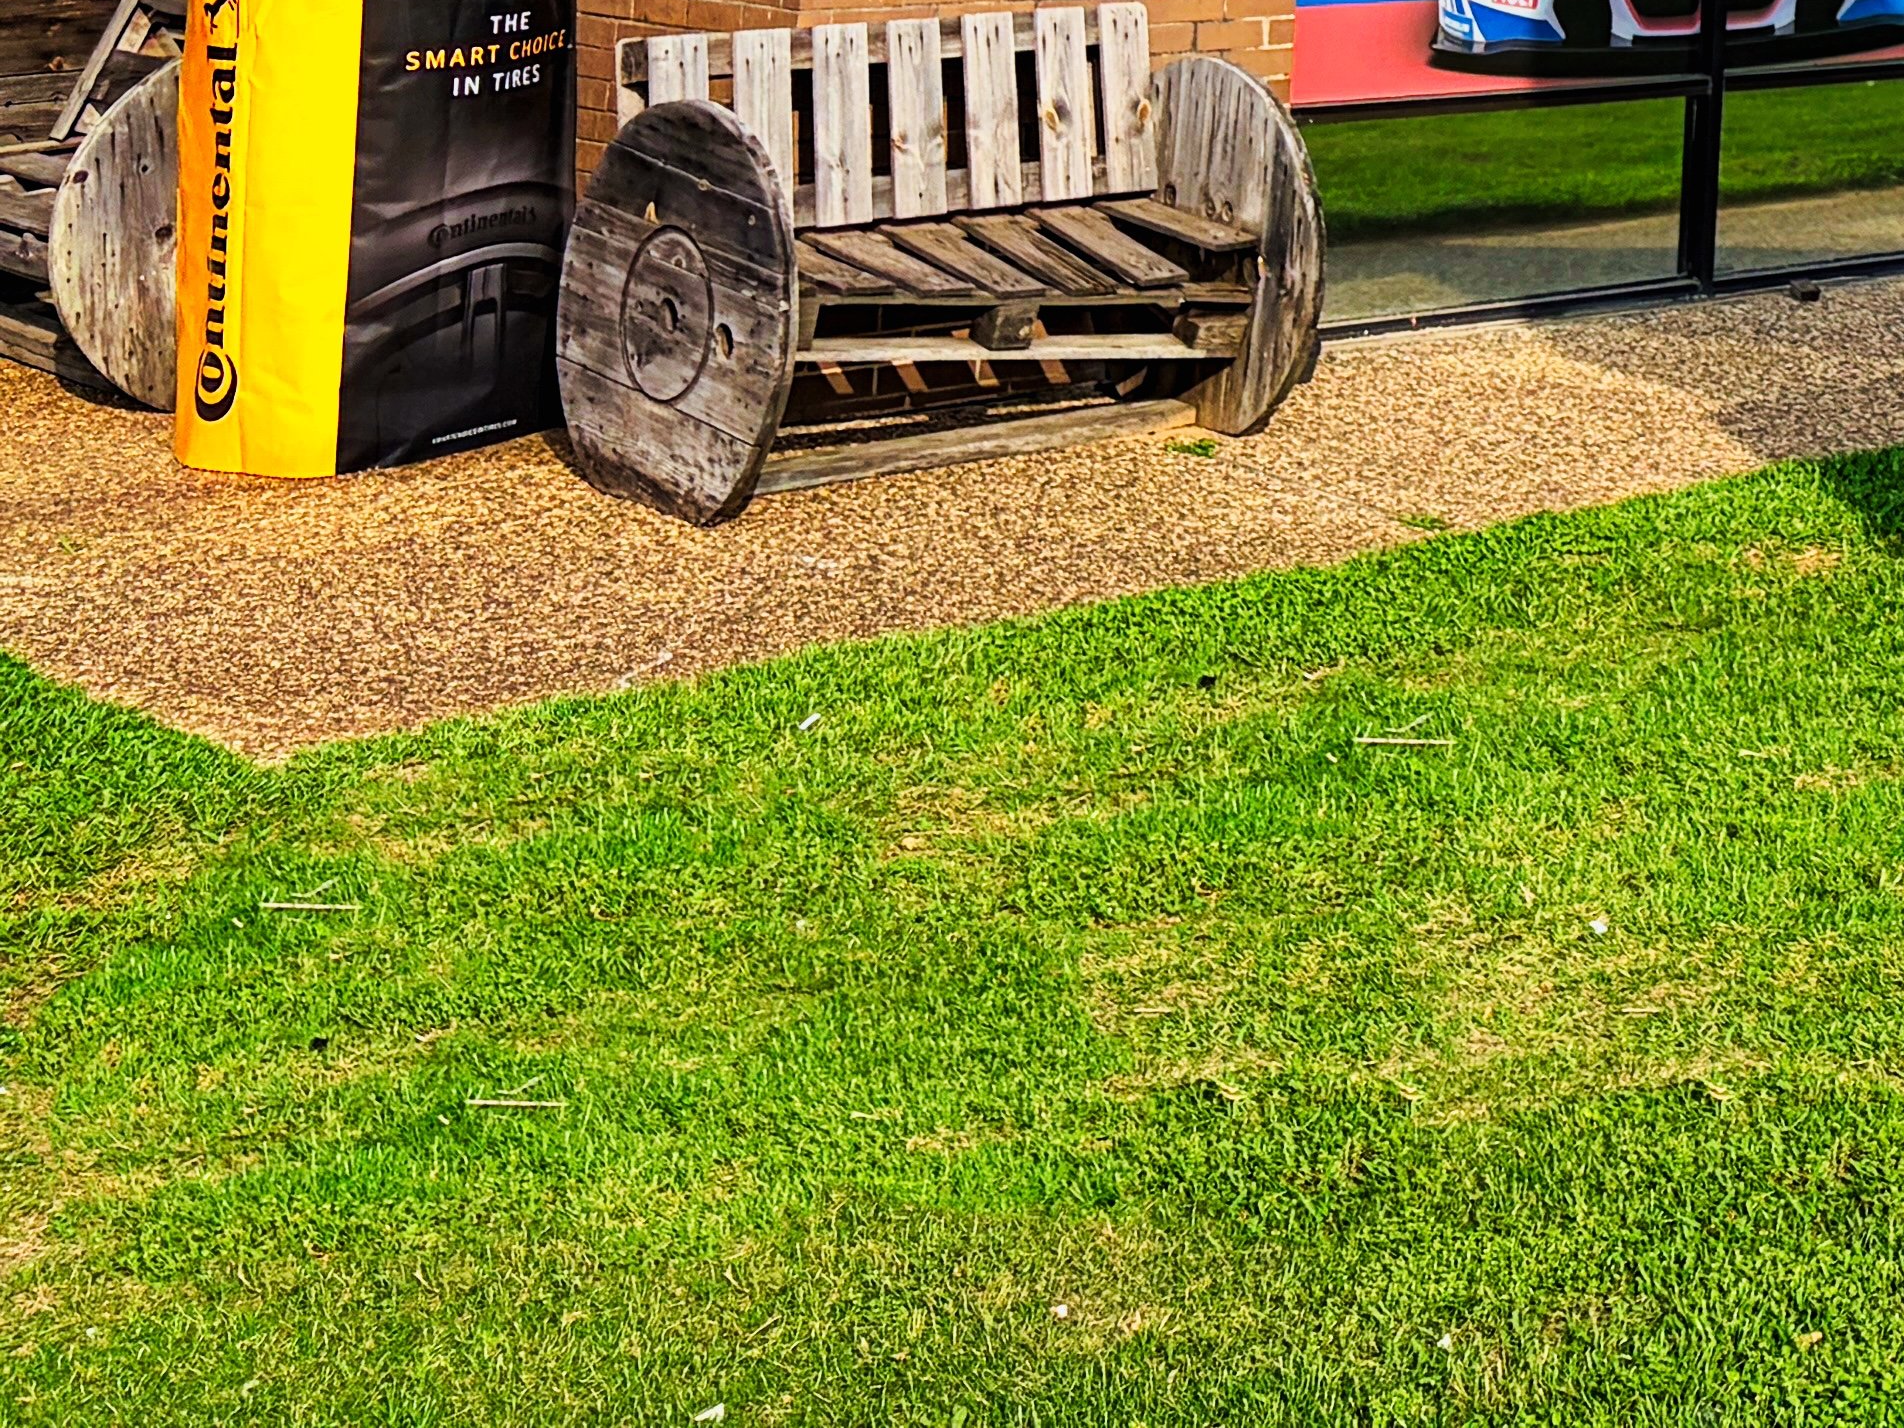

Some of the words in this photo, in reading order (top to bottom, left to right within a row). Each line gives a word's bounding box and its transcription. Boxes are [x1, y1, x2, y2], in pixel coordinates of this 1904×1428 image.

[490, 11, 532, 35] THE
[405, 44, 499, 71] SMART
[452, 75, 480, 97] IN
[492, 63, 541, 92] TIRES
